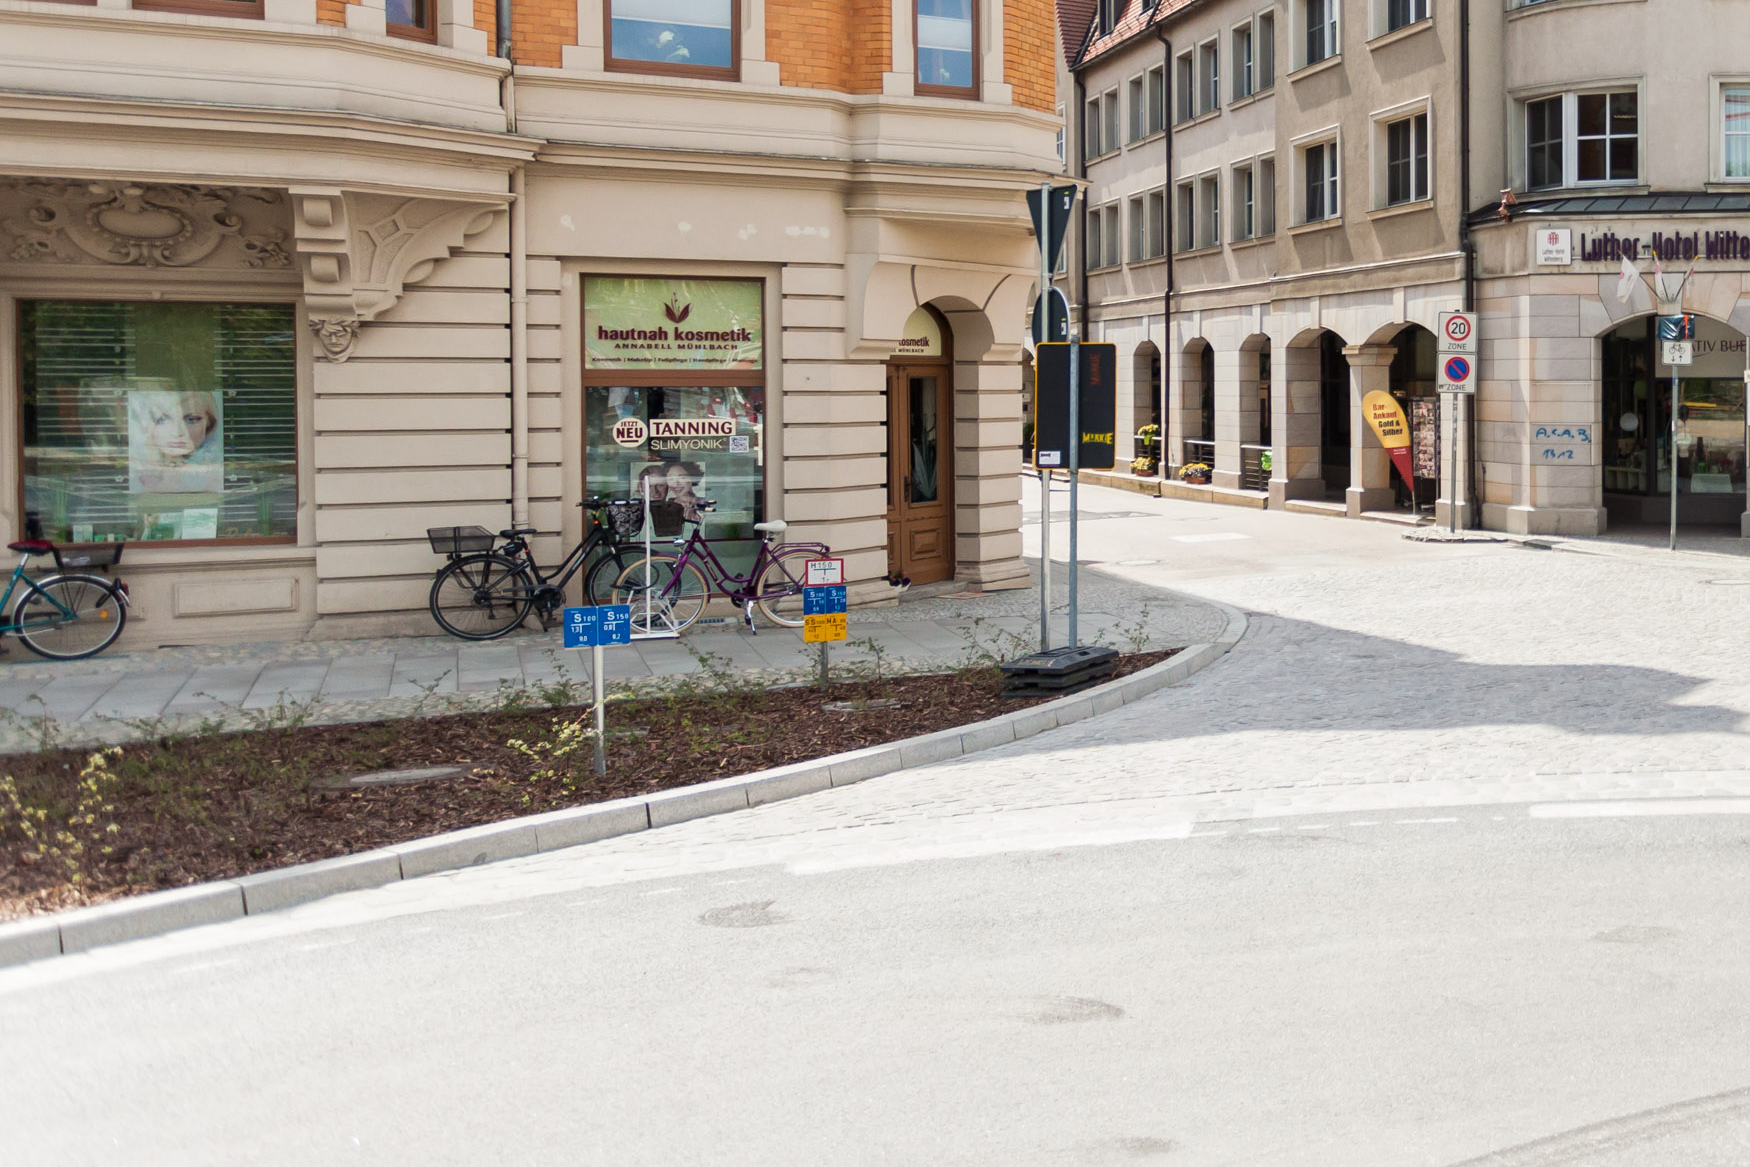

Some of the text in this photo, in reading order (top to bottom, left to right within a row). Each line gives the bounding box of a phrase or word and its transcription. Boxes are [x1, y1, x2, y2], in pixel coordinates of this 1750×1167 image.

[1580, 231, 1698, 262] Luther-Hotel
[598, 325, 752, 342] hautnah kosmetik
[1451, 322, 1466, 335] 20
[1447, 342, 1467, 350] ZONE
[1446, 383, 1467, 391] ZONE
[653, 422, 732, 435] TANNING
[1378, 420, 1394, 428] Gold
[616, 427, 643, 439] NEU
[1382, 428, 1403, 436] Silber
